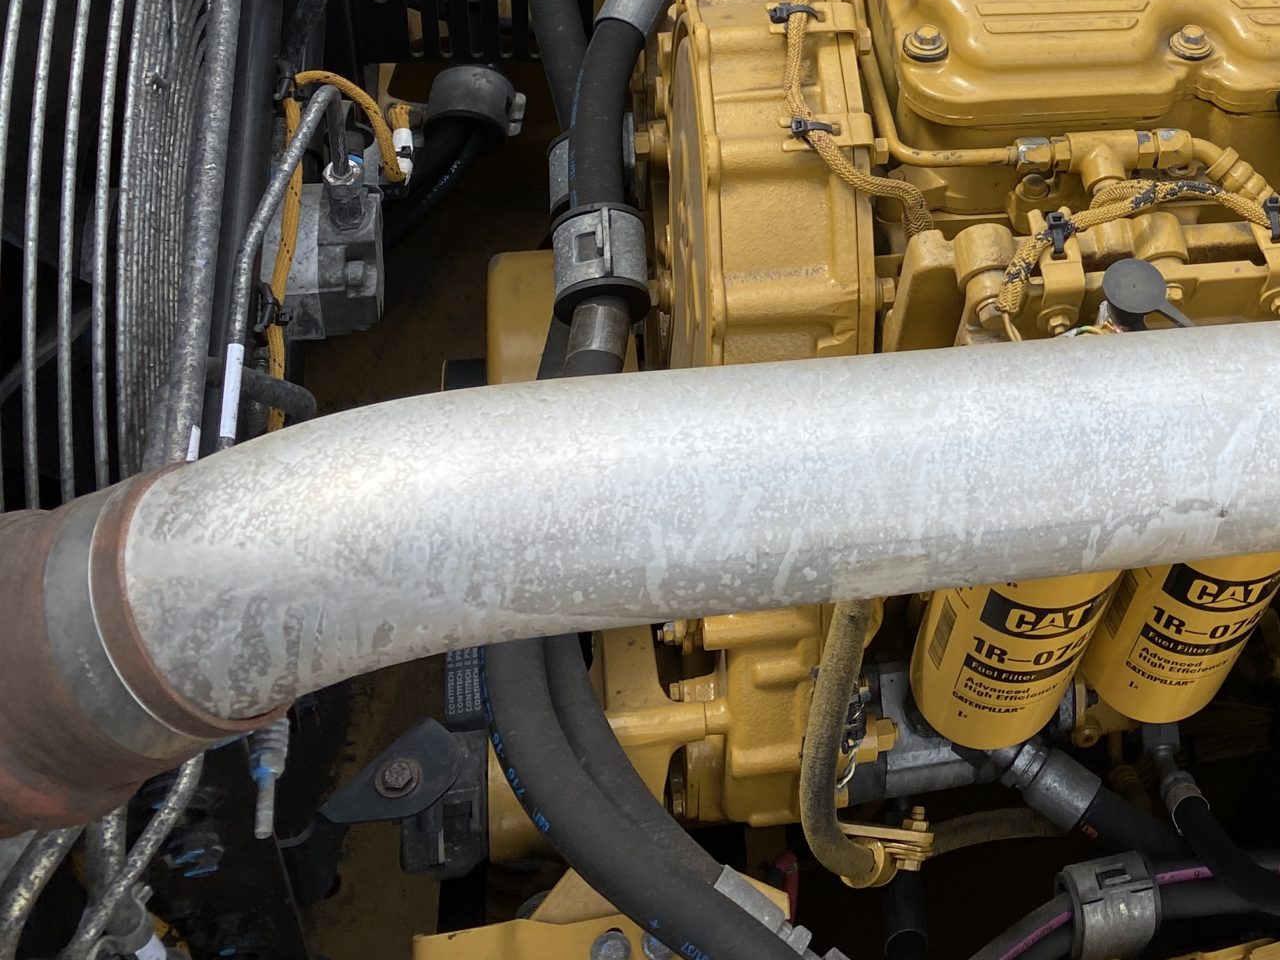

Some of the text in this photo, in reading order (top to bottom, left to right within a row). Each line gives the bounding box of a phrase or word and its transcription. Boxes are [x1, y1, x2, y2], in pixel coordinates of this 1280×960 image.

[1187, 579, 1272, 607] CAT
[1005, 602, 1093, 635] CAT
[1149, 631, 1212, 655] Fuel Filter
[1138, 652, 1230, 675] High Efficiency
[1140, 646, 1203, 668] Advanced
[971, 661, 1037, 682] Fuel Filter
[1125, 660, 1191, 687] CATERPILLAR
[448, 671, 456, 715] CONTITECH
[456, 670, 464, 714] CONTITECH
[464, 668, 472, 712] CONTITECH
[472, 667, 481, 711] CONTITECH
[963, 682, 1058, 702] High Efficiency
[965, 676, 1031, 695] Advanced
[952, 690, 1019, 714] CATERPILLAR
